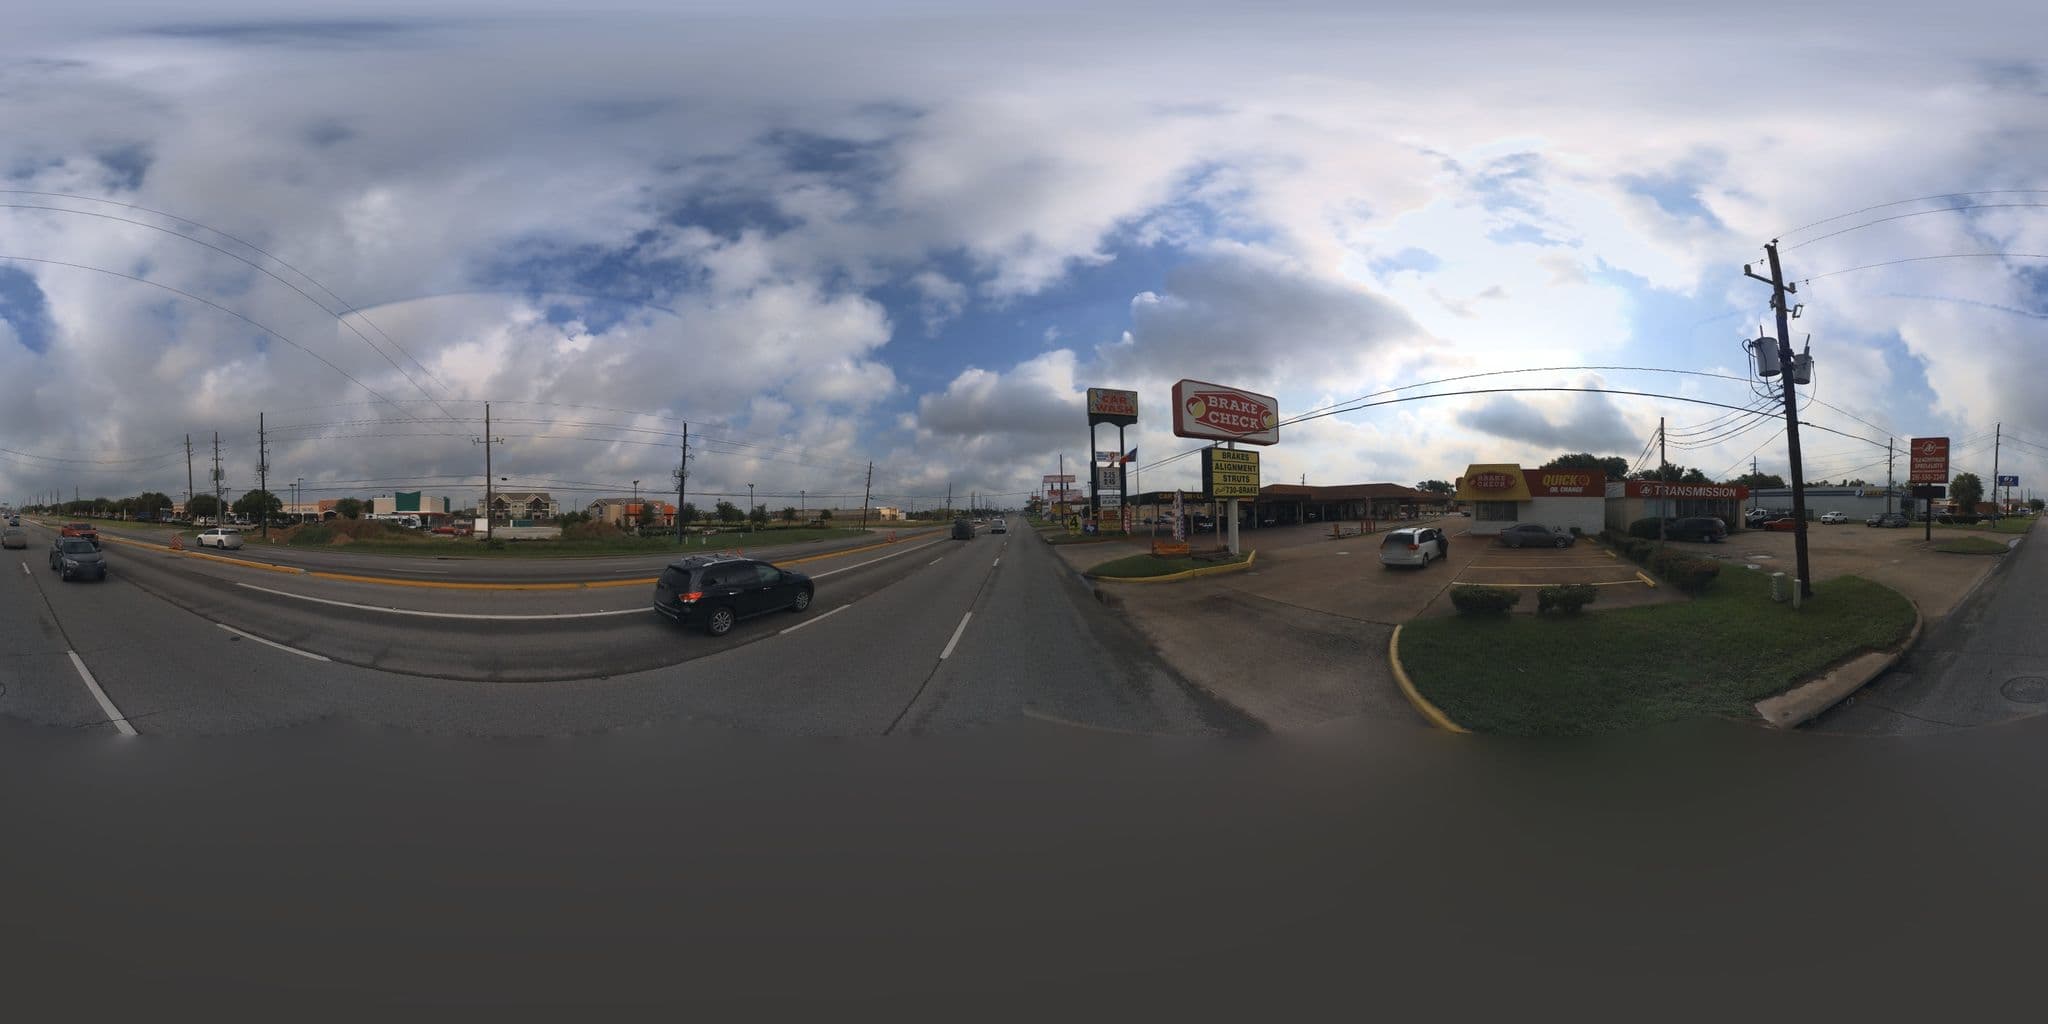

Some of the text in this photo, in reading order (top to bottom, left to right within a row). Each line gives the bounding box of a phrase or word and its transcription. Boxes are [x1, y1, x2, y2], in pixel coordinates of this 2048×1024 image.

[1101, 394, 1127, 405] CAR
[1207, 396, 1258, 414] BRAKE
[1096, 403, 1135, 414] WASH
[1208, 412, 1259, 429] CHECK
[1222, 451, 1249, 461] BRAKES
[1214, 463, 1256, 472] ALIGNMENT
[1222, 474, 1250, 483] STRUTS
[1543, 474, 1577, 487] QUICK
[1226, 486, 1257, 495] 730-BRAKE
[1655, 485, 1737, 497] TRANSMISSION
